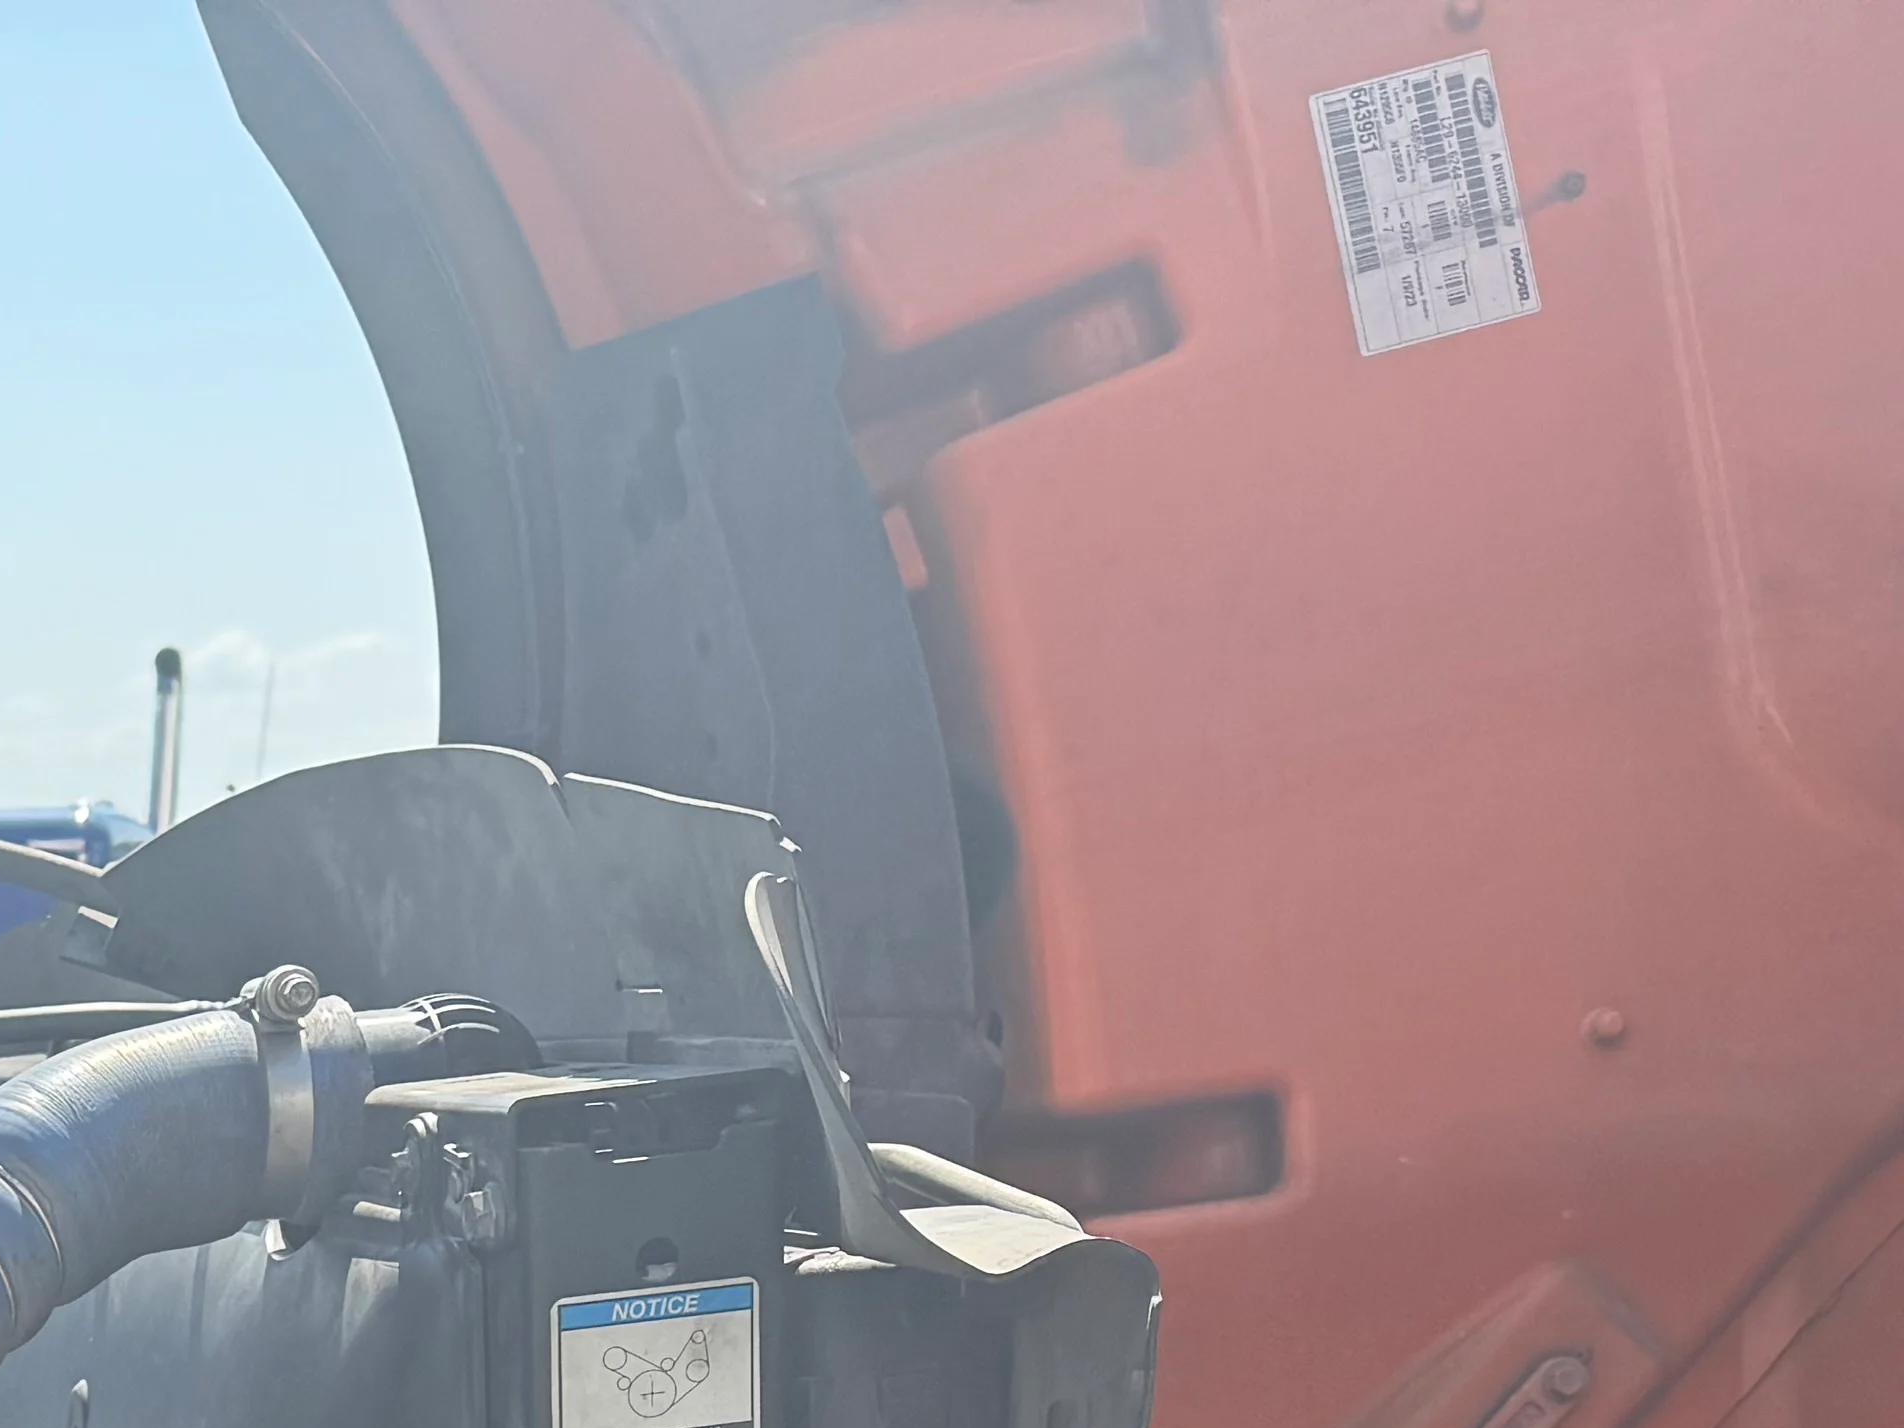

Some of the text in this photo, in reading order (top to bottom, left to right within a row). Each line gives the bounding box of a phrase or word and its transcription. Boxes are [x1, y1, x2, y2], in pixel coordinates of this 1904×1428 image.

[1348, 88, 1379, 156] 643951
[1492, 164, 1511, 210] DIVISION
[1510, 247, 1531, 302] PACCAR
[612, 1294, 700, 1321] NOTICE
